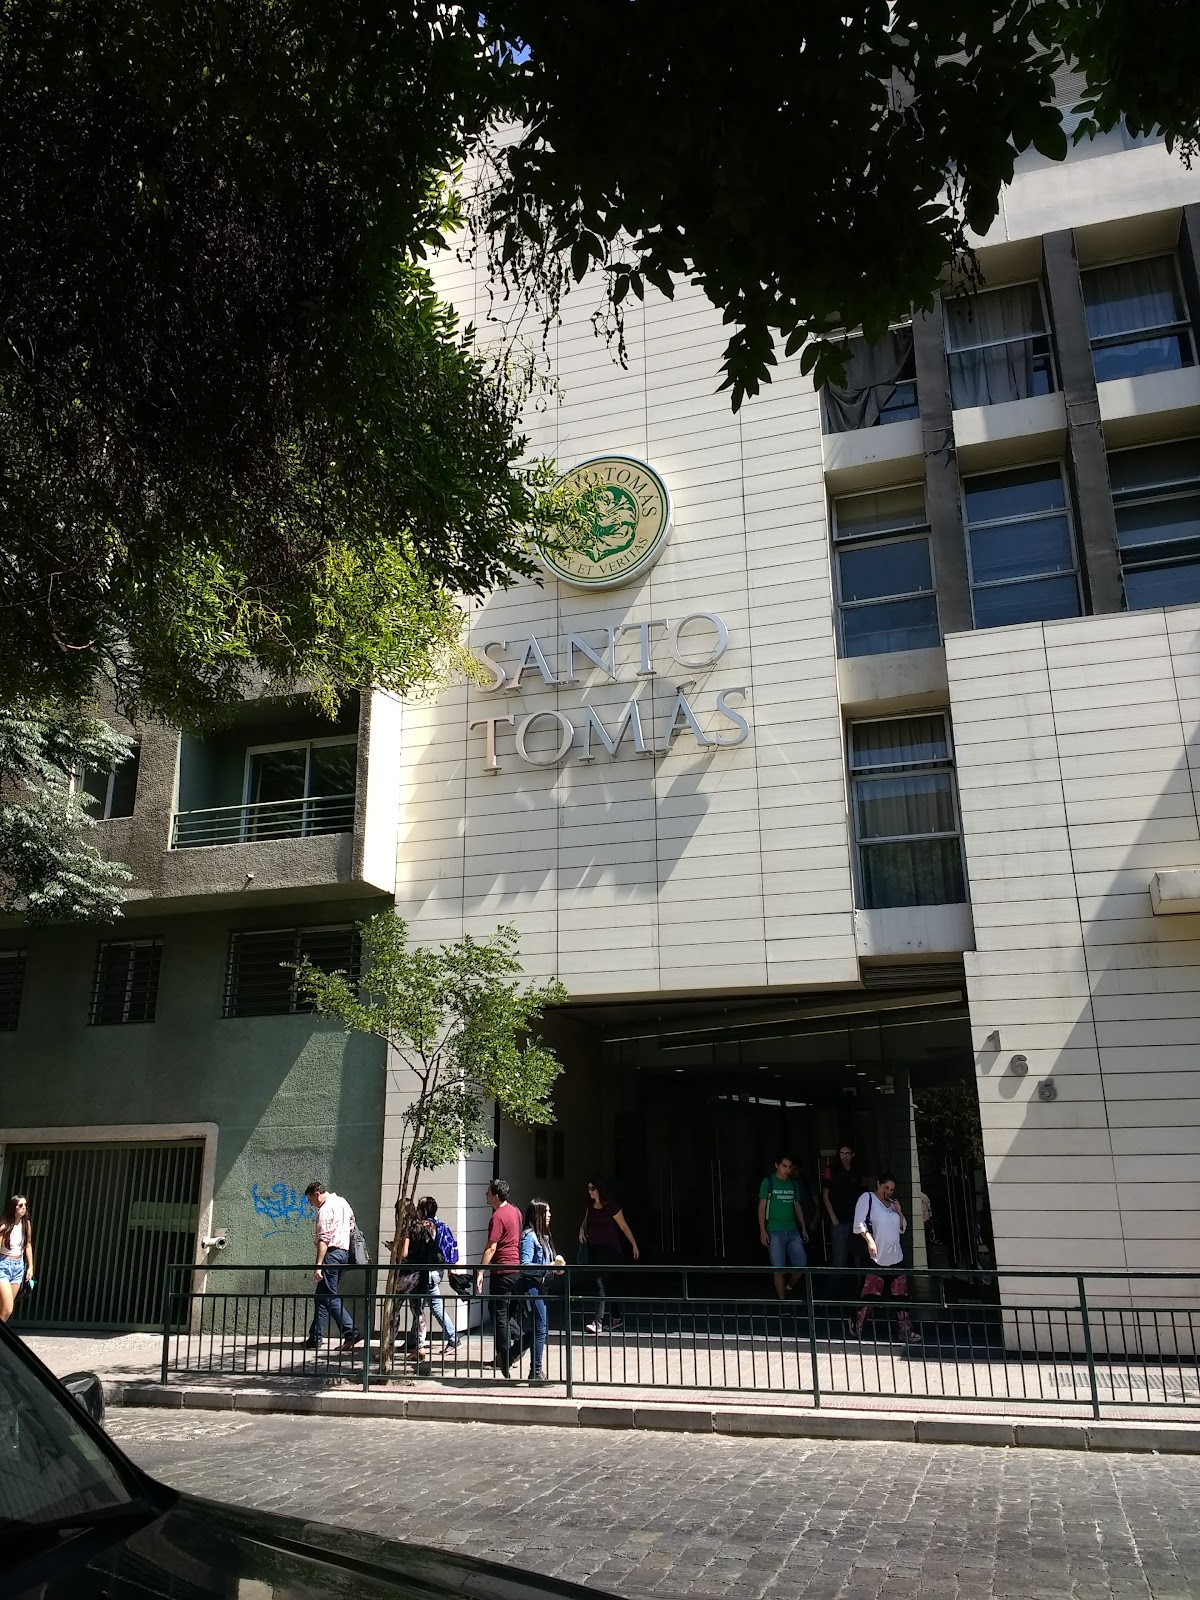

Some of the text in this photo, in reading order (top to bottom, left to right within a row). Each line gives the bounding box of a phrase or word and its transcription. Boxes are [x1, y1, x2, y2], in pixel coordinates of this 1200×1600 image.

[604, 467, 659, 518] TOMÁS
[577, 564, 594, 575] ET
[599, 537, 648, 574] VERITAS
[474, 612, 729, 695] SANTO
[470, 678, 750, 775] TOMÁS
